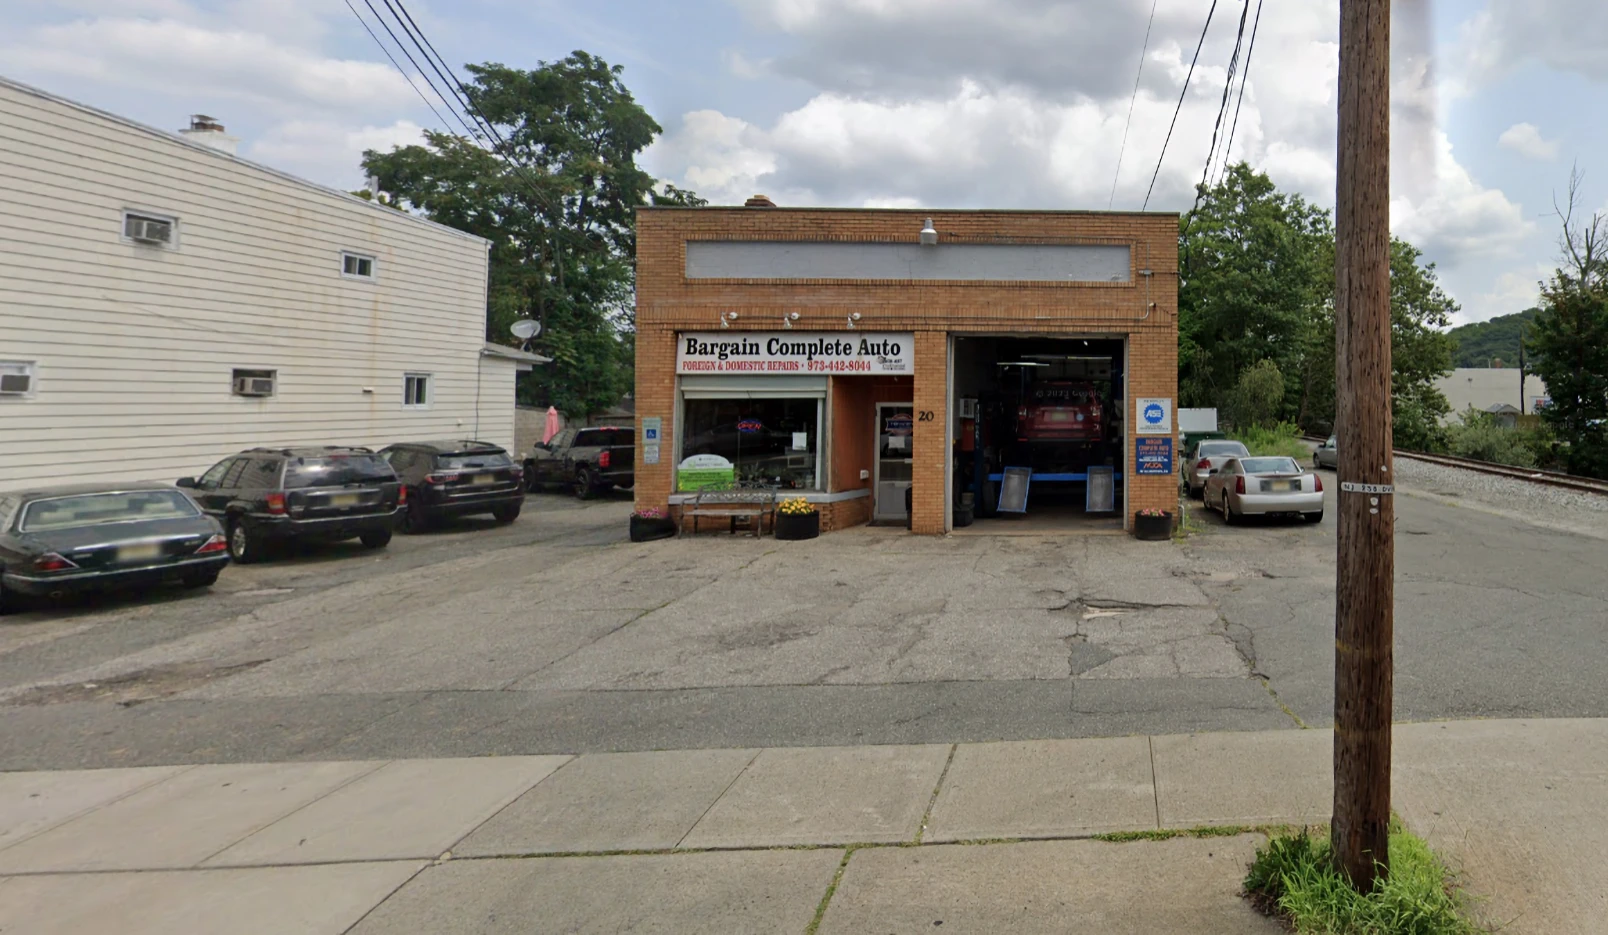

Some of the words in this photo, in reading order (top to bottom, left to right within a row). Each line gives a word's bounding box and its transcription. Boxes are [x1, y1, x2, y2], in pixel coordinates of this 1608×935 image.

[685, 337, 760, 360] Bargain
[766, 338, 852, 360] Complete
[857, 338, 901, 356] Auto
[682, 361, 716, 371] FOREIGN
[718, 361, 723, 371] &
[725, 361, 766, 371] DOMESTIC
[767, 361, 799, 371] REPAIRS
[807, 360, 871, 371] 973-442-8044
[918, 410, 935, 422] 20
[1145, 409, 1162, 418] ASE
[737, 422, 761, 430] OPEN
